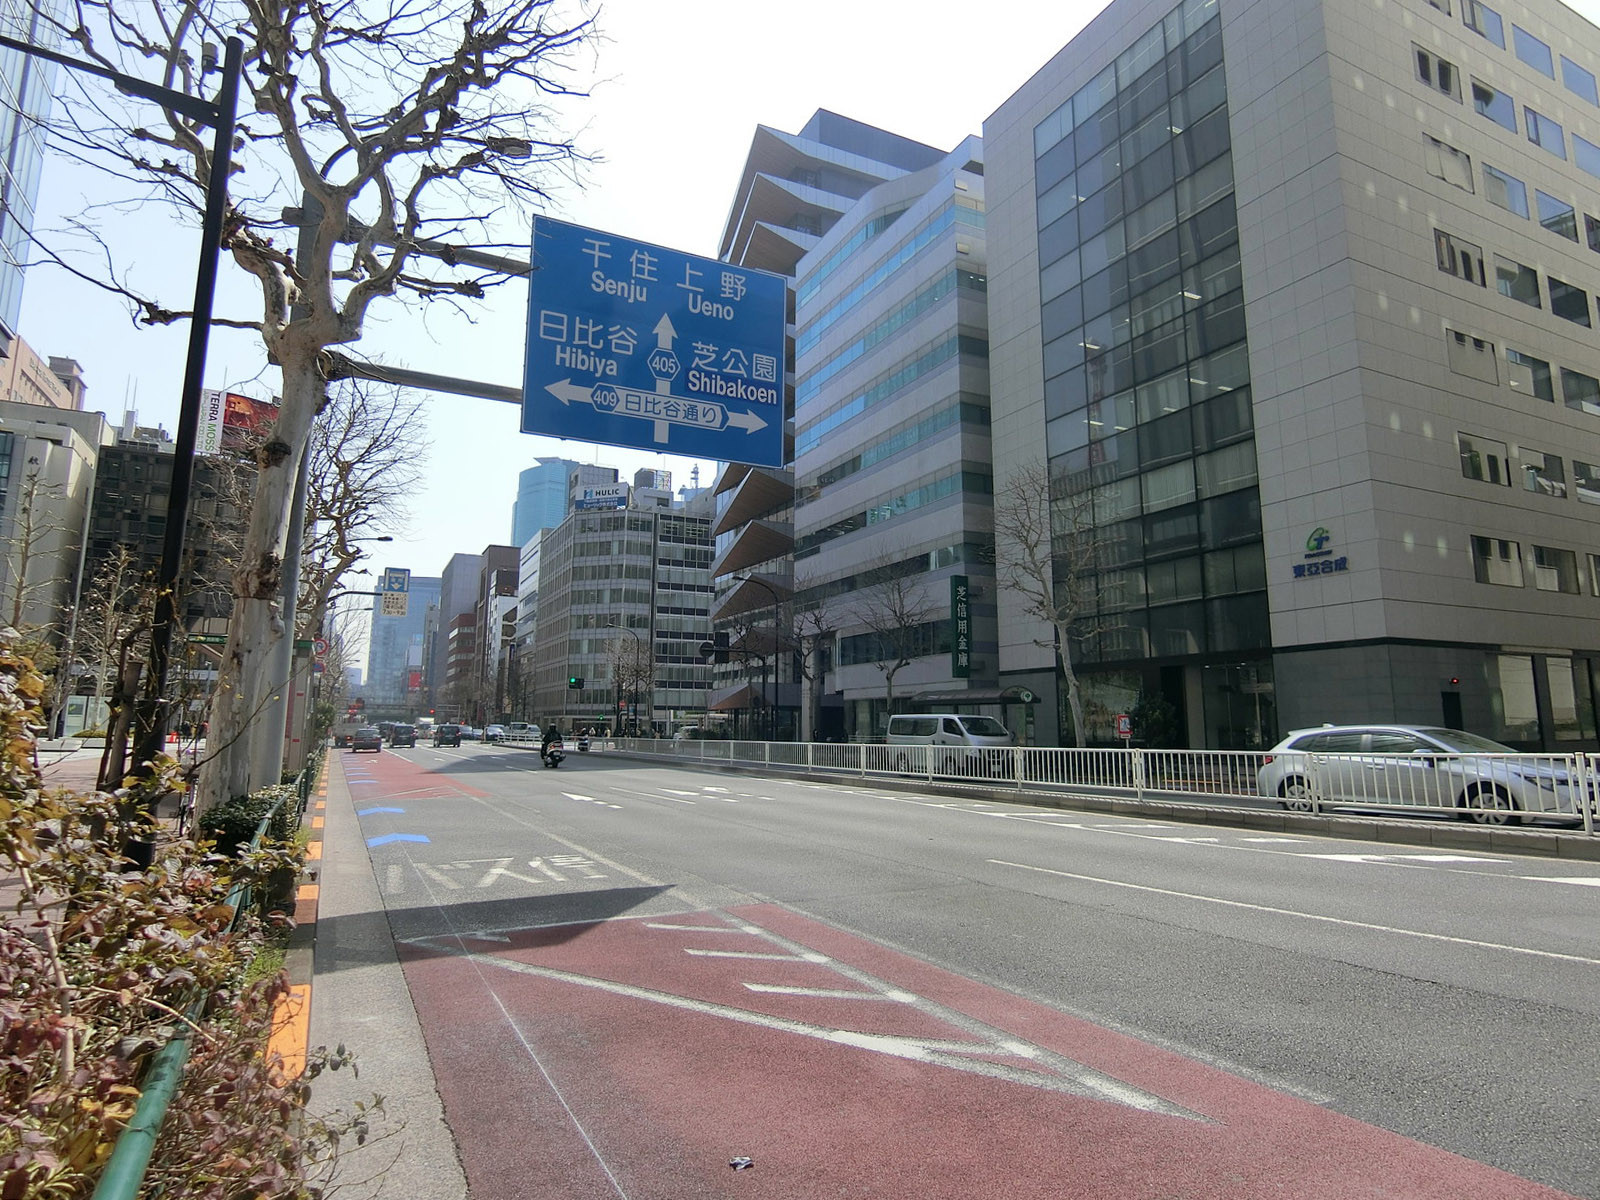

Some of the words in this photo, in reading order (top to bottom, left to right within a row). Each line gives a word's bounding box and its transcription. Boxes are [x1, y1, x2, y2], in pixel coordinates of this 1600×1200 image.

[582, 239, 658, 282] 千住
[676, 262, 747, 301] 上野
[591, 271, 647, 303] Senju
[688, 294, 734, 320] Ueno
[540, 310, 638, 355] 日比谷
[555, 345, 618, 377] Hibiya
[651, 356, 676, 375] 405
[692, 341, 777, 382] 芝公園
[593, 388, 617, 407] 409
[688, 370, 777, 405] Shibakoen
[209, 393, 219, 421] TERRA
[625, 395, 717, 424] 日比谷通り
[205, 424, 216, 452] MOSS
[956, 585, 968, 668] 芝信用金庫
